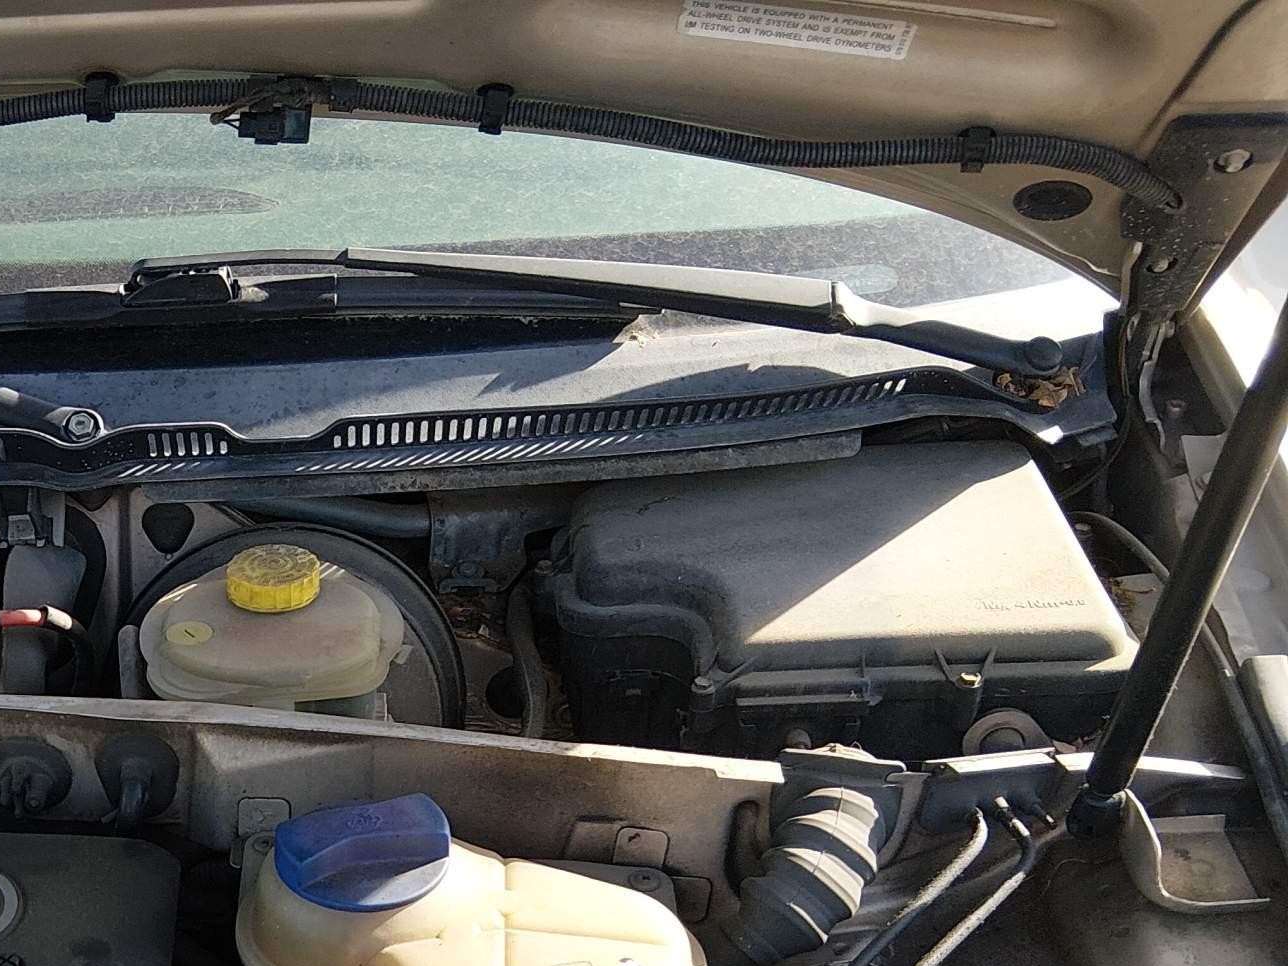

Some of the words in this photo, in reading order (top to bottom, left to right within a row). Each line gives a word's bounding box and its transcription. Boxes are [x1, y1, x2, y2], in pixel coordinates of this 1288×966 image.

[687, 9, 733, 22] ALL-WHEEL
[736, 15, 763, 25] DRIVE
[765, 18, 800, 29] SYSTEM
[801, 23, 820, 32] AND
[833, 26, 869, 38] EXEMPT
[870, 31, 896, 41] FROM
[691, 0, 711, 9] THIS
[714, 2, 749, 13] VEHICLE
[763, 8, 806, 20] EQUIPPED
[808, 14, 830, 22] WITH
[831, 16, 839, 24] A
[841, 18, 895, 31] PERMANENT
[700, 22, 735, 34] TESTING
[737, 26, 751, 35] ON
[754, 28, 803, 41] TWO-WHEEL
[806, 34, 832, 46] DRIVE
[834, 38, 893, 53] DYNOMETERS
